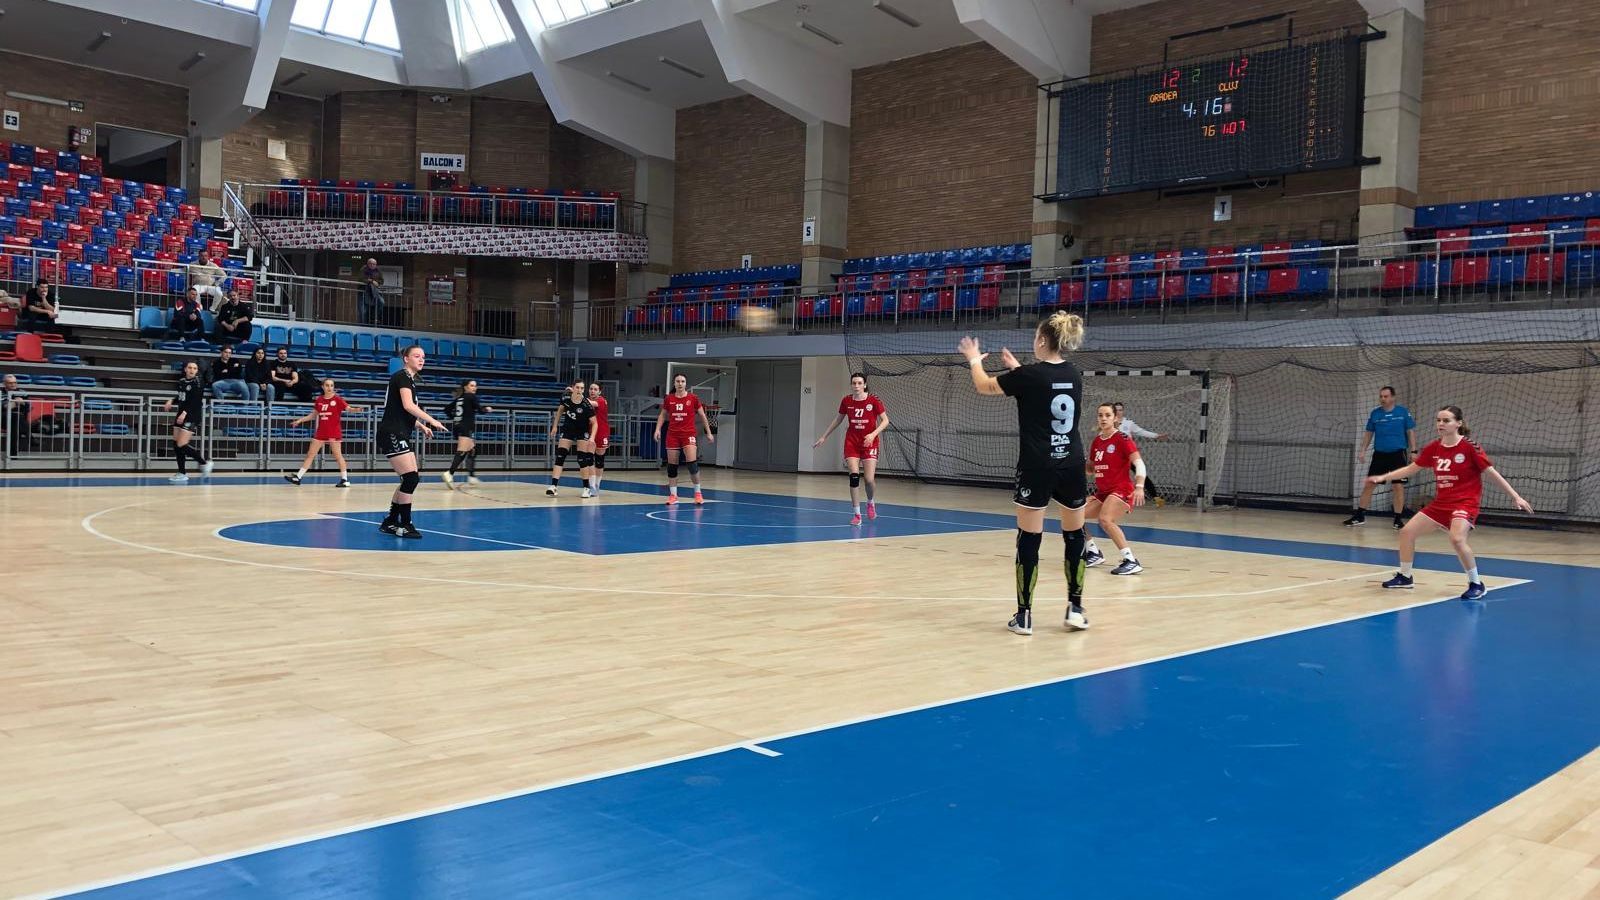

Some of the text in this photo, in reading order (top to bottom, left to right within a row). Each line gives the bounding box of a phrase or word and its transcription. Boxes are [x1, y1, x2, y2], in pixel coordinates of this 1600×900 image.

[1162, 70, 1180, 88] 12
[1192, 69, 1200, 82] 2
[1218, 81, 1239, 92] CLUJ
[1183, 97, 1223, 118] 4:16
[1201, 120, 1245, 136] 76 1:07
[423, 157, 462, 168] BALCON 2
[1220, 201, 1227, 214] T
[675, 403, 683, 411] 13
[855, 409, 864, 418] 27
[1051, 394, 1074, 434] 9
[1095, 451, 1104, 462] 24
[1437, 459, 1452, 471] 22
